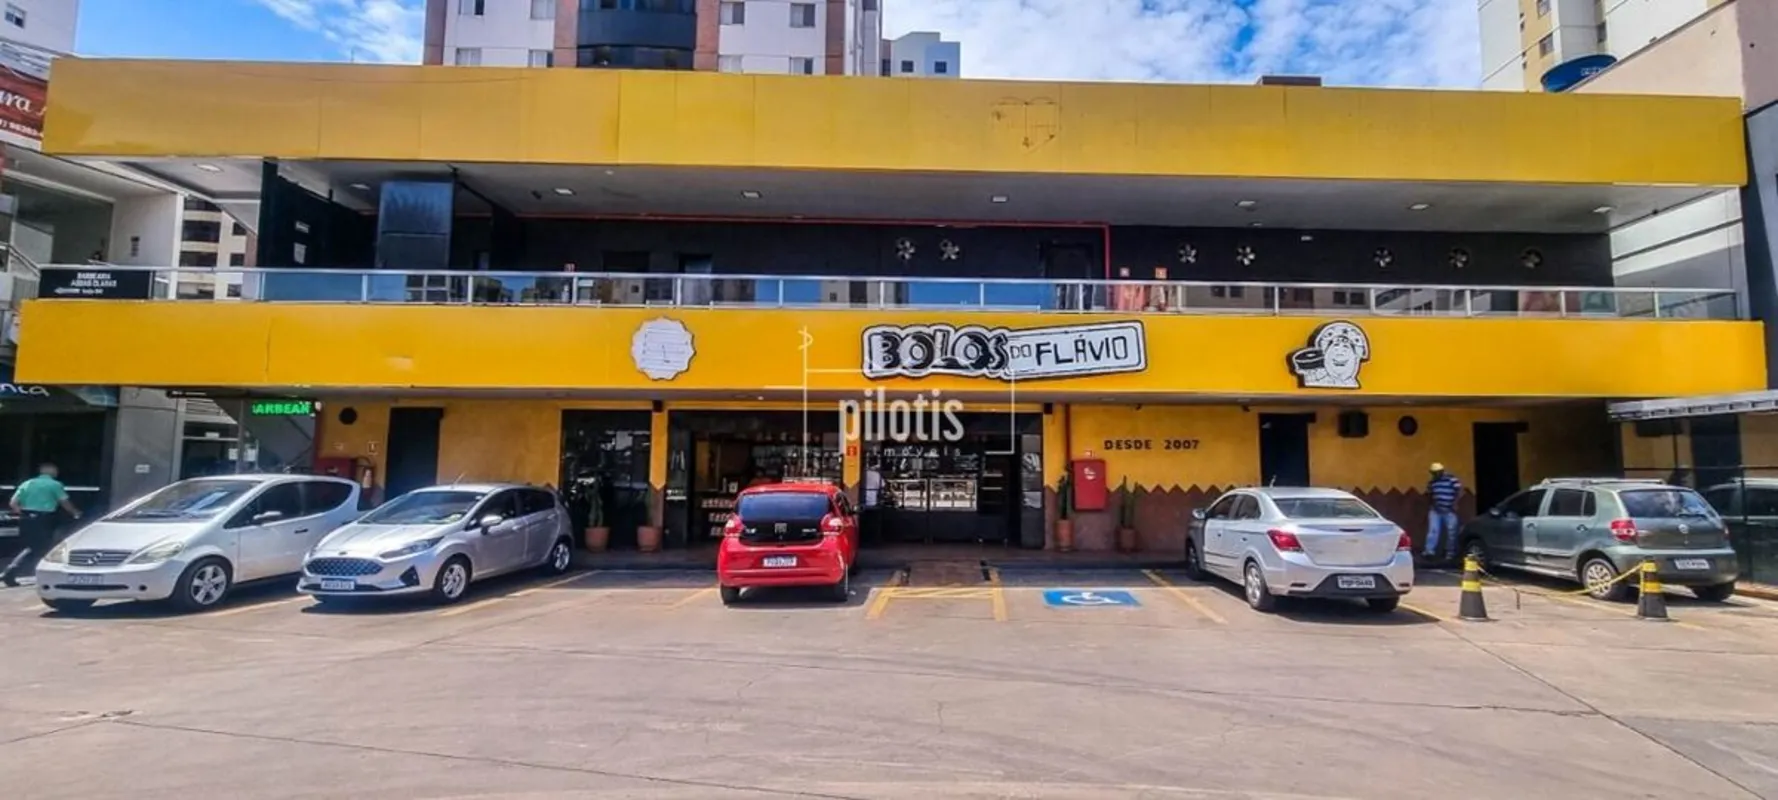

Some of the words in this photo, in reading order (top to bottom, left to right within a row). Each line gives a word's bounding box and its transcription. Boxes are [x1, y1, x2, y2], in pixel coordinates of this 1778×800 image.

[866, 328, 1008, 371] BOLOS
[1009, 344, 1032, 360] DO
[1036, 333, 1129, 367] FLÁVIO
[1103, 439, 1153, 451] DESDE
[1164, 439, 1201, 451] 2007
